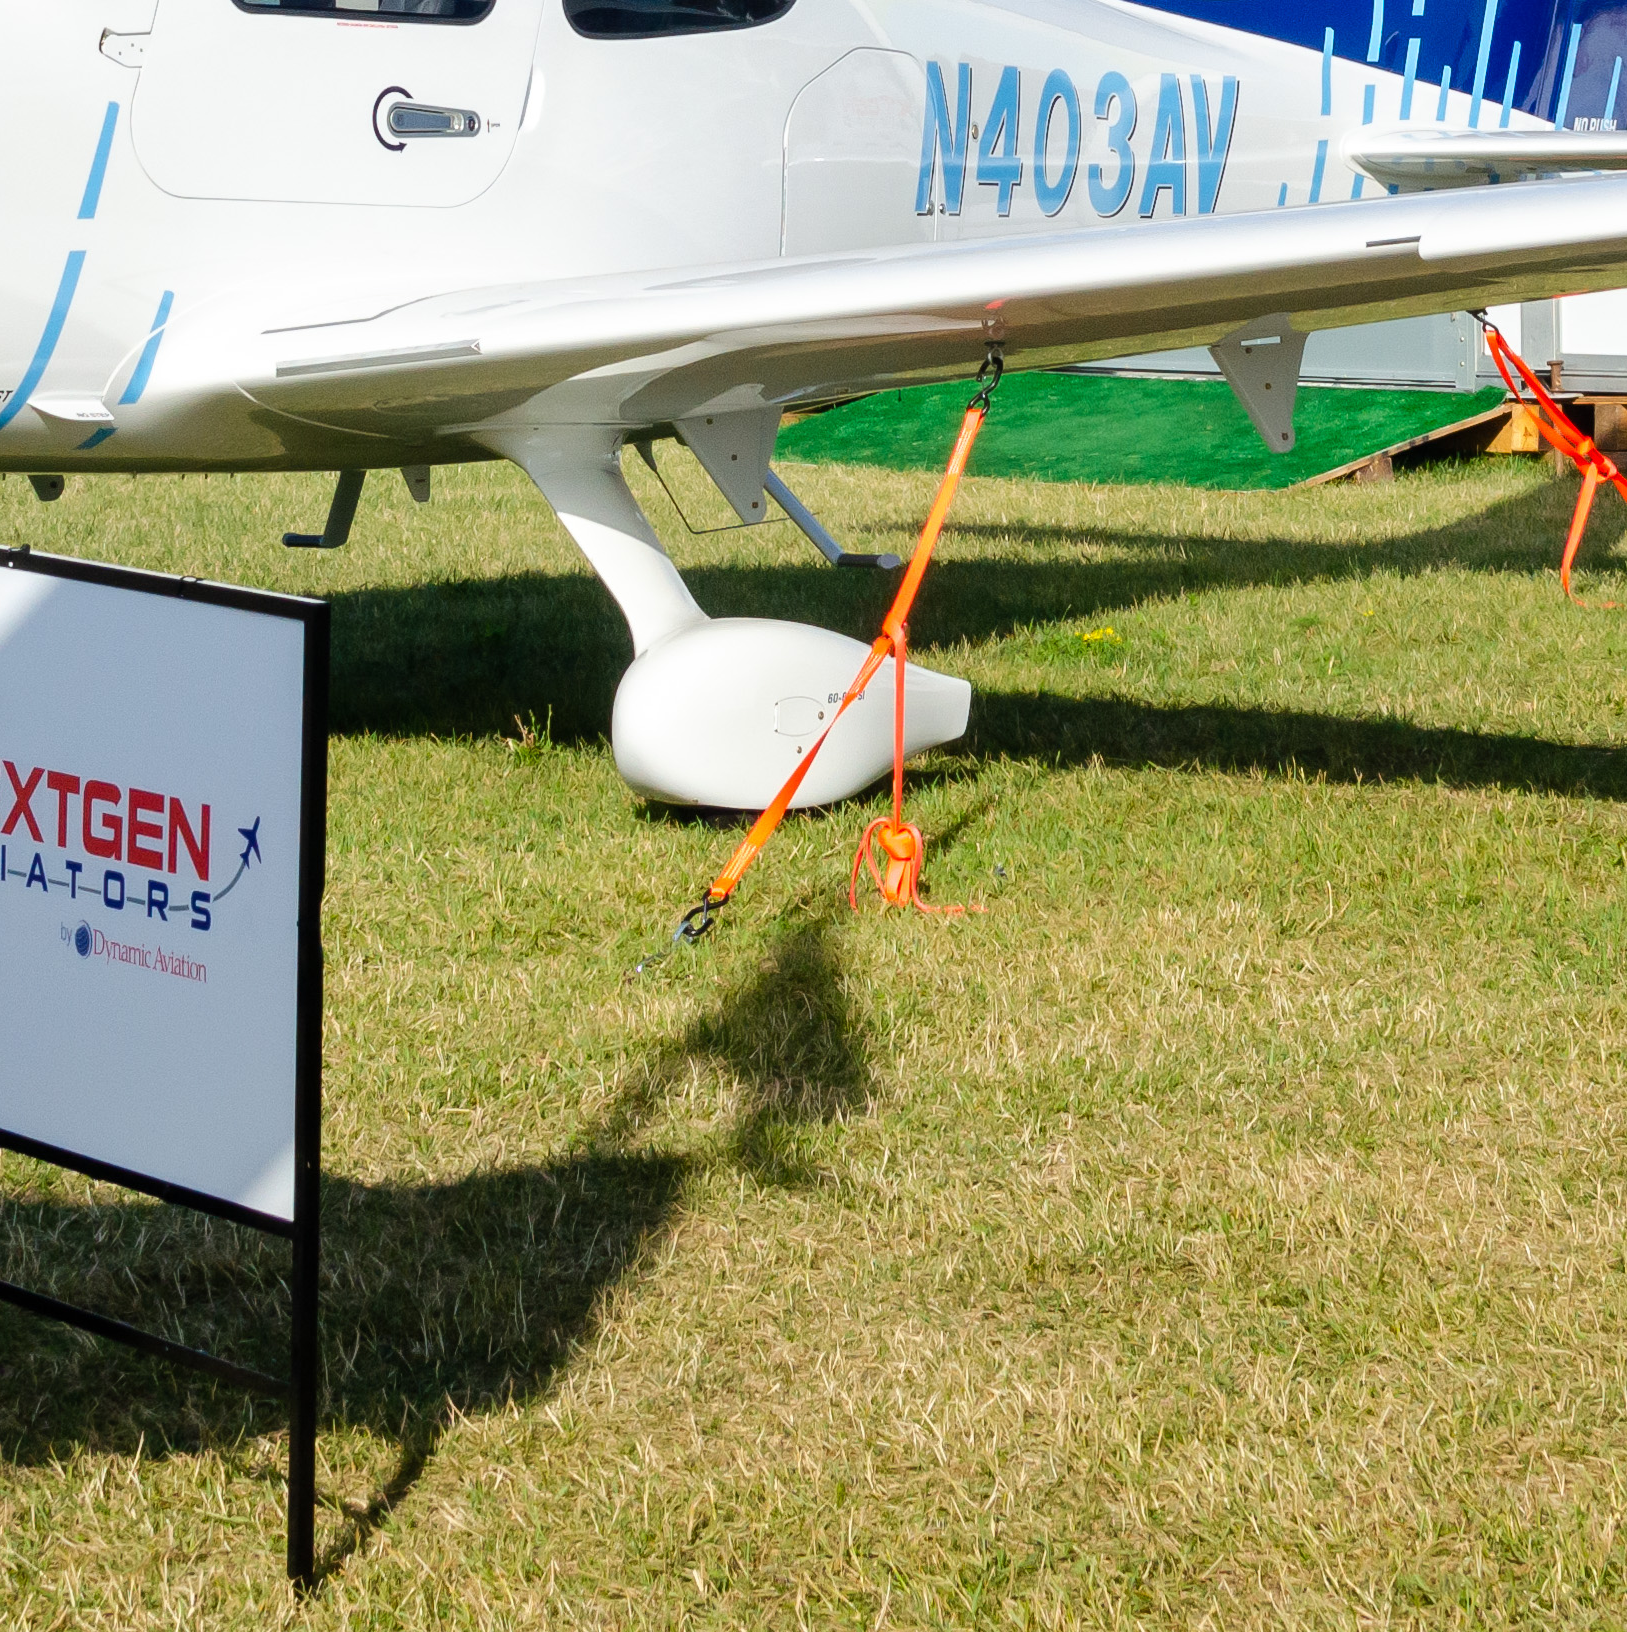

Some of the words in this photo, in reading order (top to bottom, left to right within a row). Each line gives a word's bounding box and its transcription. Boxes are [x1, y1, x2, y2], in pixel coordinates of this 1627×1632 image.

[914, 61, 1240, 219] N403AV
[60, 921, 72, 947] by
[93, 928, 152, 970] Dynamic
[152, 945, 208, 985] Aviation
